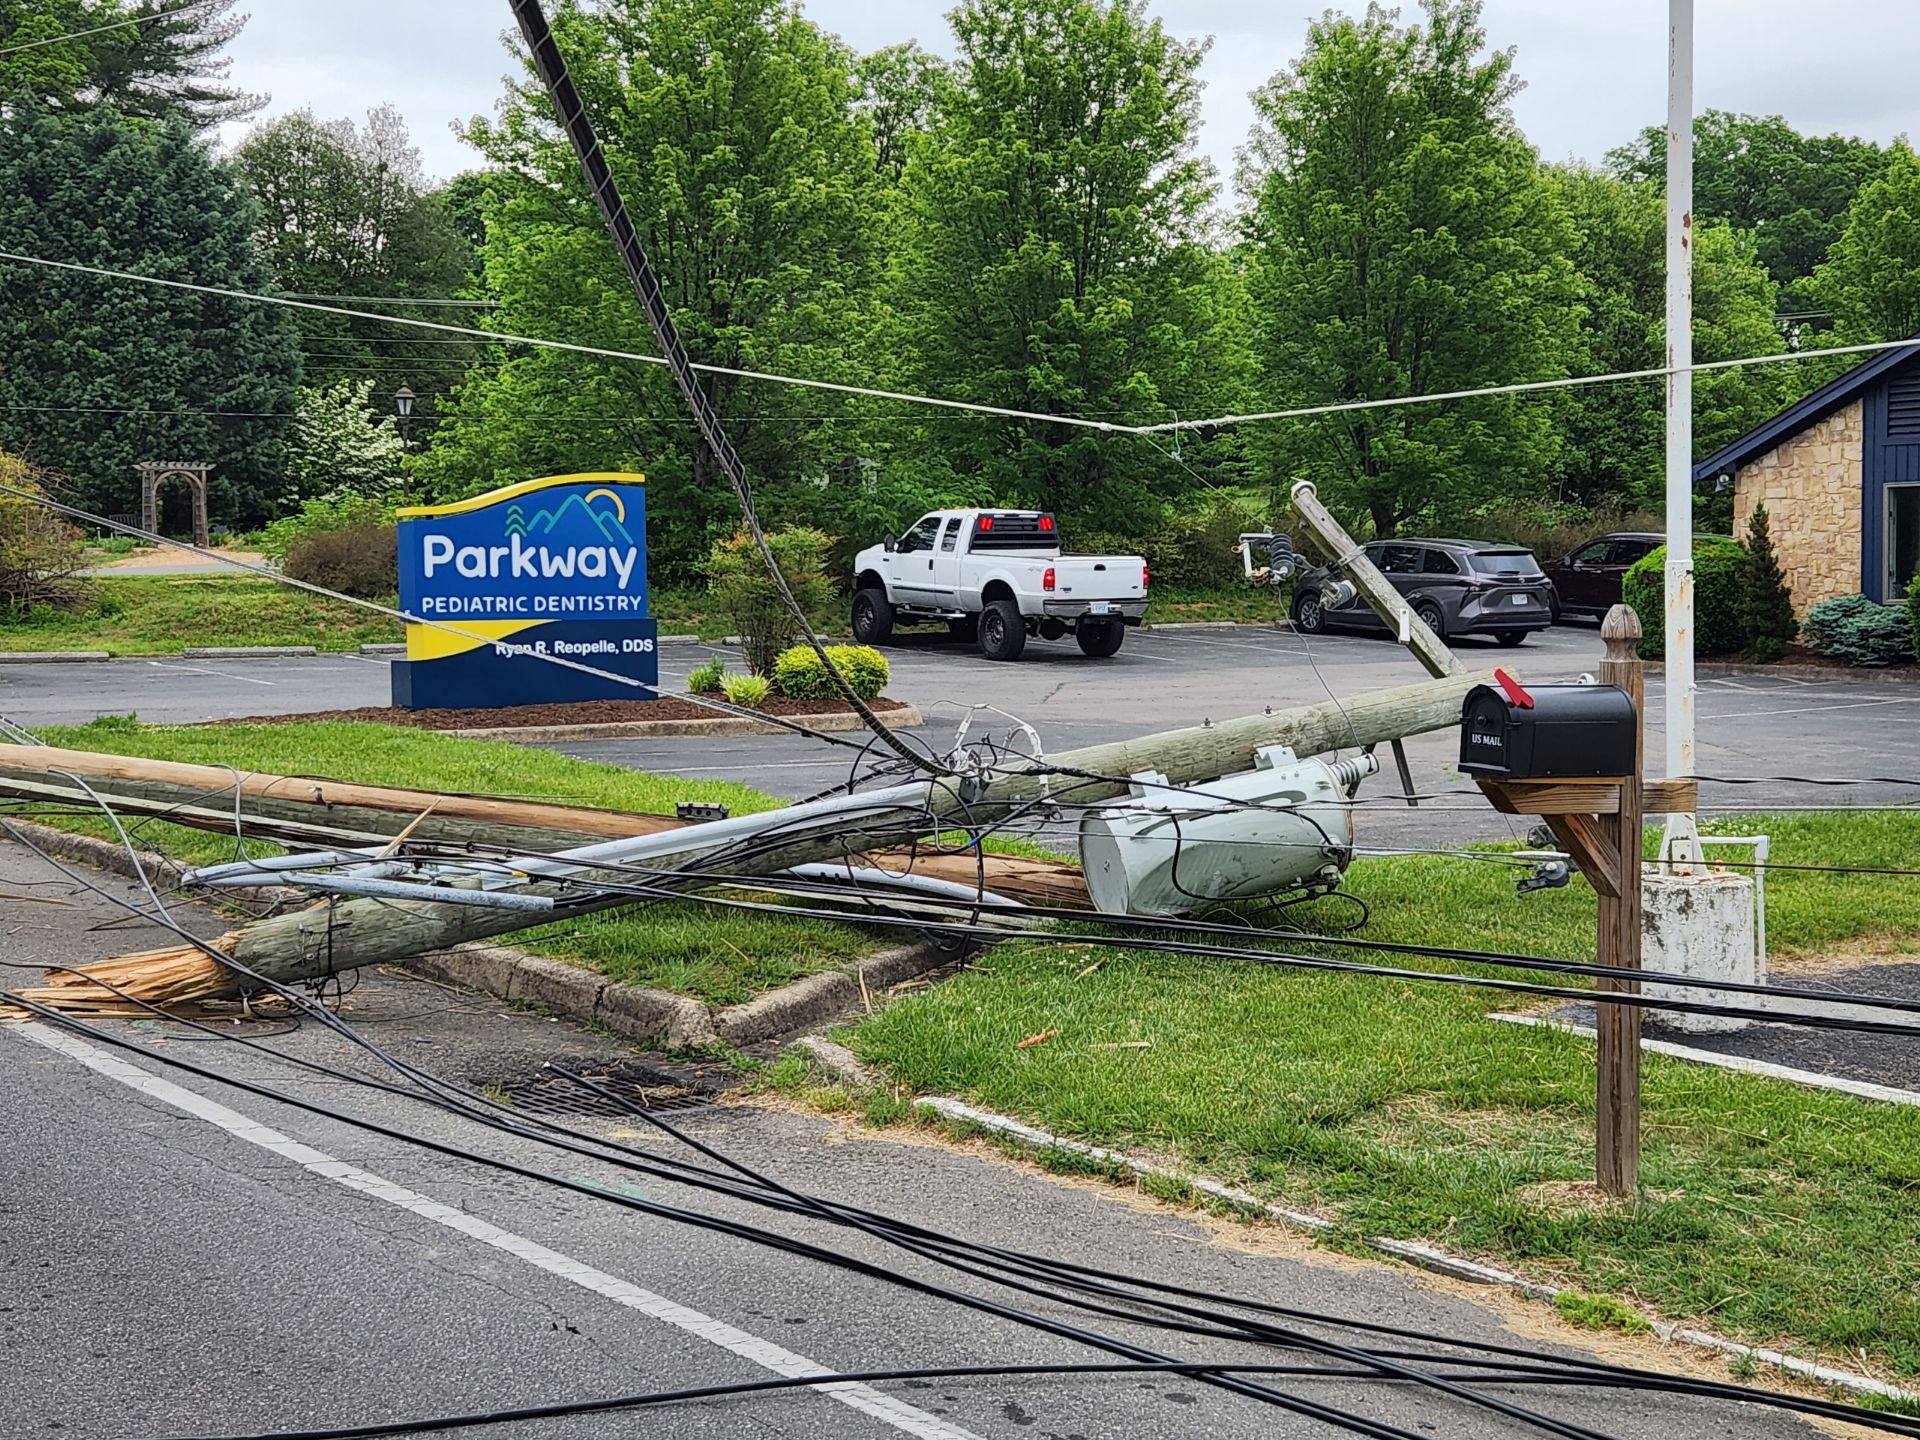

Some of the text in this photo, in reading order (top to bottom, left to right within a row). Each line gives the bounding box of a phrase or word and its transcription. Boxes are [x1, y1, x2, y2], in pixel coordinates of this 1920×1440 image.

[423, 532, 638, 590] Parkway
[422, 595, 642, 613] PEDIATRIC DENTISTRY
[535, 641, 551, 654] R.
[554, 640, 619, 656] Reopelle,
[623, 639, 654, 652] DDS
[1471, 733, 1503, 747] US MAIL
